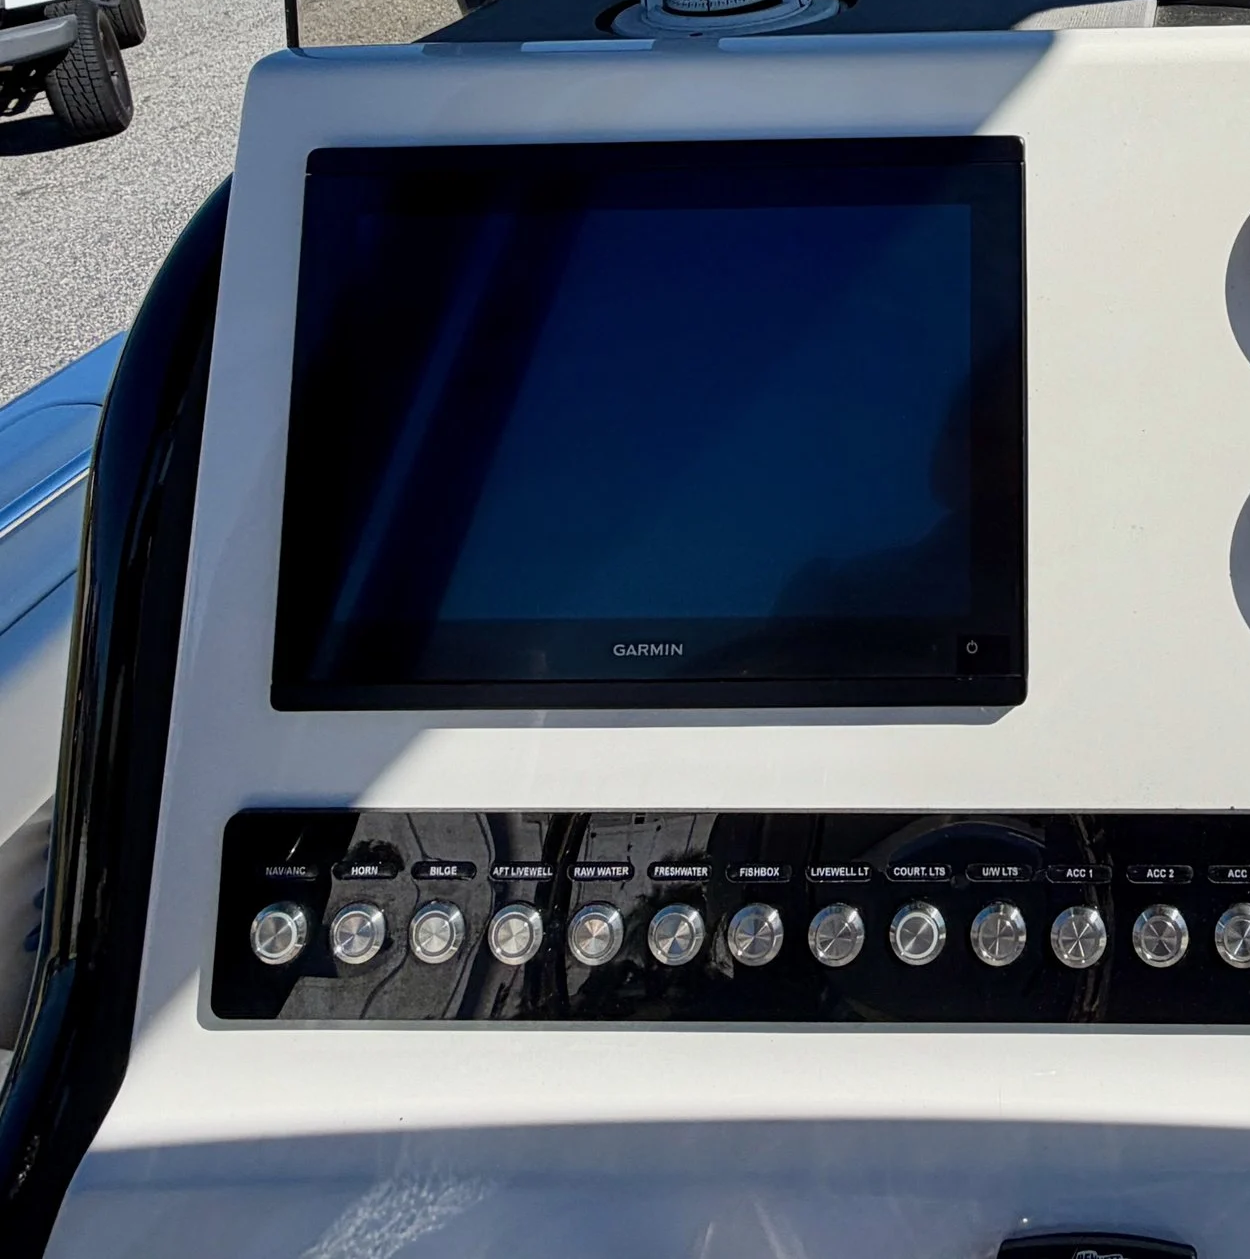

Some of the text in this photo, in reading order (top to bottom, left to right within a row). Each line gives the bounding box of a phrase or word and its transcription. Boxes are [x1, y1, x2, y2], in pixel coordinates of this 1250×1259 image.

[613, 643, 684, 657] GARMIN
[350, 866, 379, 876] HORN
[429, 866, 458, 876] BILGE
[492, 866, 553, 876] AFT LIVEWELL
[573, 866, 630, 877] RAW WATER
[654, 866, 709, 877] FRESHWATER
[739, 867, 780, 877] FISHBOX
[810, 867, 870, 877] LIVEWELL LT
[893, 867, 946, 877] COURT. LTS
[982, 867, 1019, 877] U/W LTS
[1066, 869, 1093, 878] ACC 1
[1146, 869, 1175, 878] ACC 2
[1227, 869, 1248, 878] ACC
